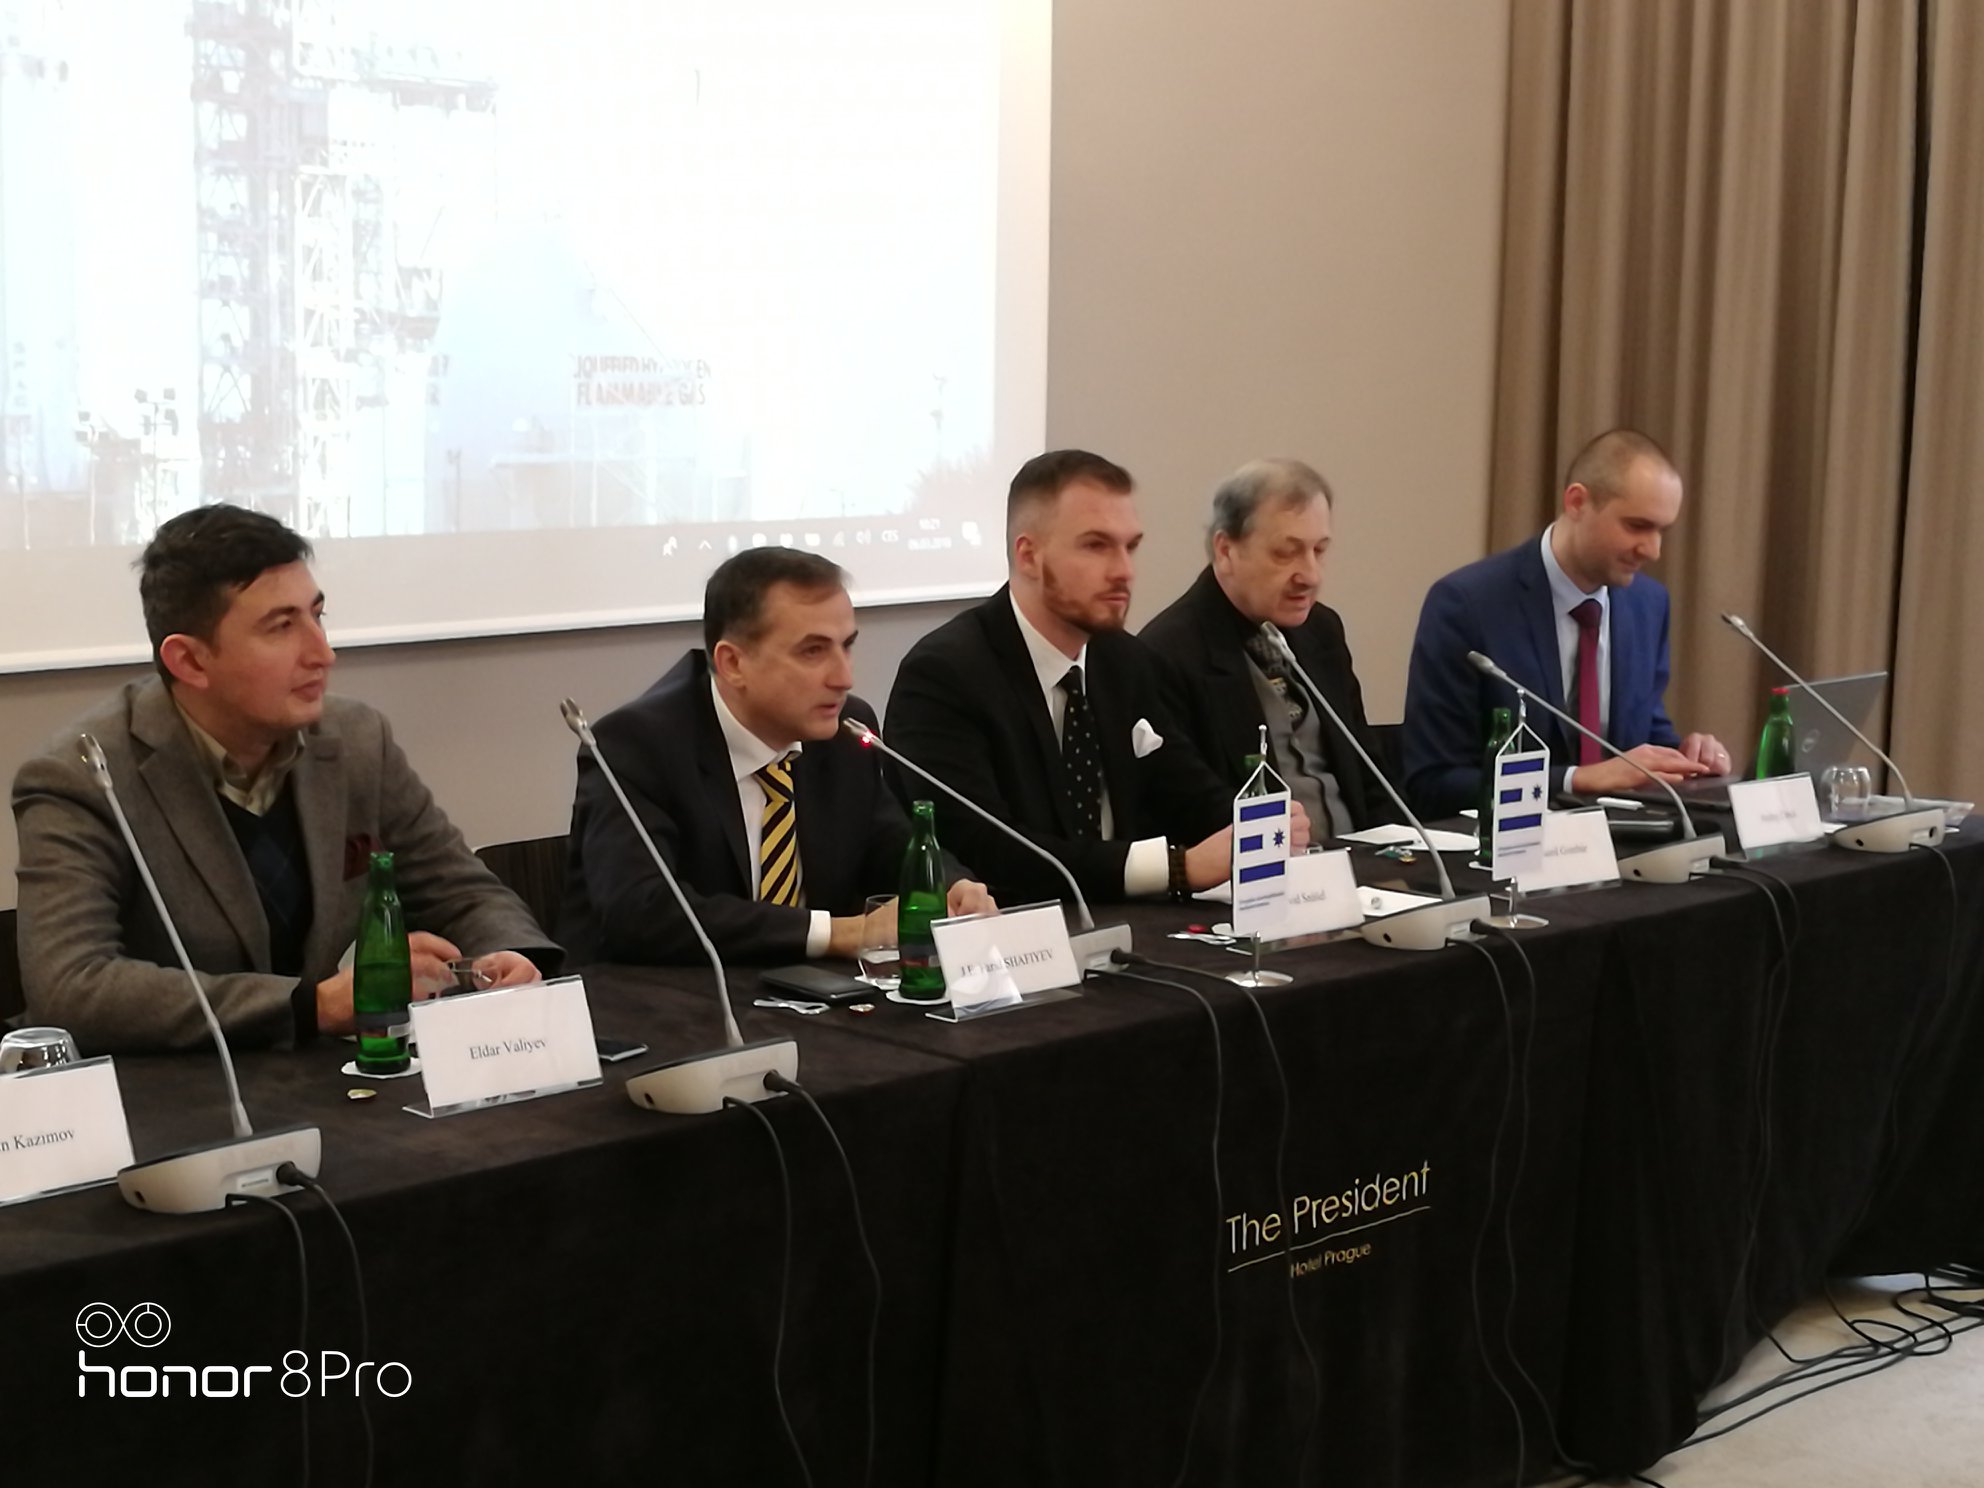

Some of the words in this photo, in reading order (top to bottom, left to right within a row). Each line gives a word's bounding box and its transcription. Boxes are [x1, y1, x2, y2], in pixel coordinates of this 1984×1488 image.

[1003, 948, 1054, 970] SHAFIYEV
[469, 1044, 501, 1060] Eldar
[503, 1037, 547, 1054] Valiyev
[14, 1128, 76, 1150] Kazimov
[1225, 1211, 1282, 1254] The
[1293, 1159, 1430, 1234] President
[1290, 1255, 1322, 1279] Hotel
[1323, 1243, 1372, 1267] Prague
